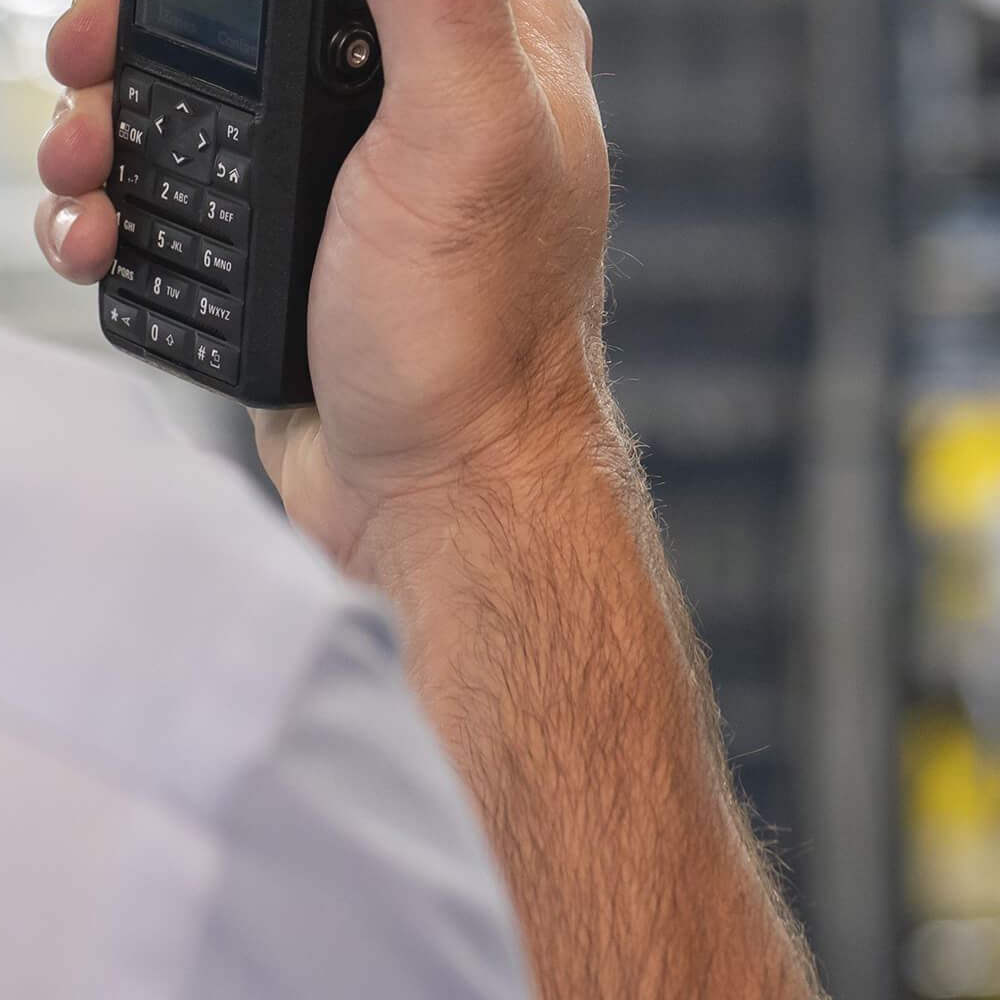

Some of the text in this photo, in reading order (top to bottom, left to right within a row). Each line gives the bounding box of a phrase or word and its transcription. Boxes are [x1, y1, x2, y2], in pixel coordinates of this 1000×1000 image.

[128, 87, 139, 103] P1
[129, 127, 143, 144] OK
[226, 125, 239, 141] P2
[119, 164, 125, 182] 1
[161, 182, 189, 205] 2 ABC
[207, 201, 235, 223] 3 DEF
[157, 230, 183, 253] 5 JKL
[203, 249, 232, 272] 6 MNO
[153, 277, 180, 300] 8 TUV
[200, 297, 231, 321] 9 WXYZ
[151, 324, 159, 342] 0
[197, 344, 206, 360] #
